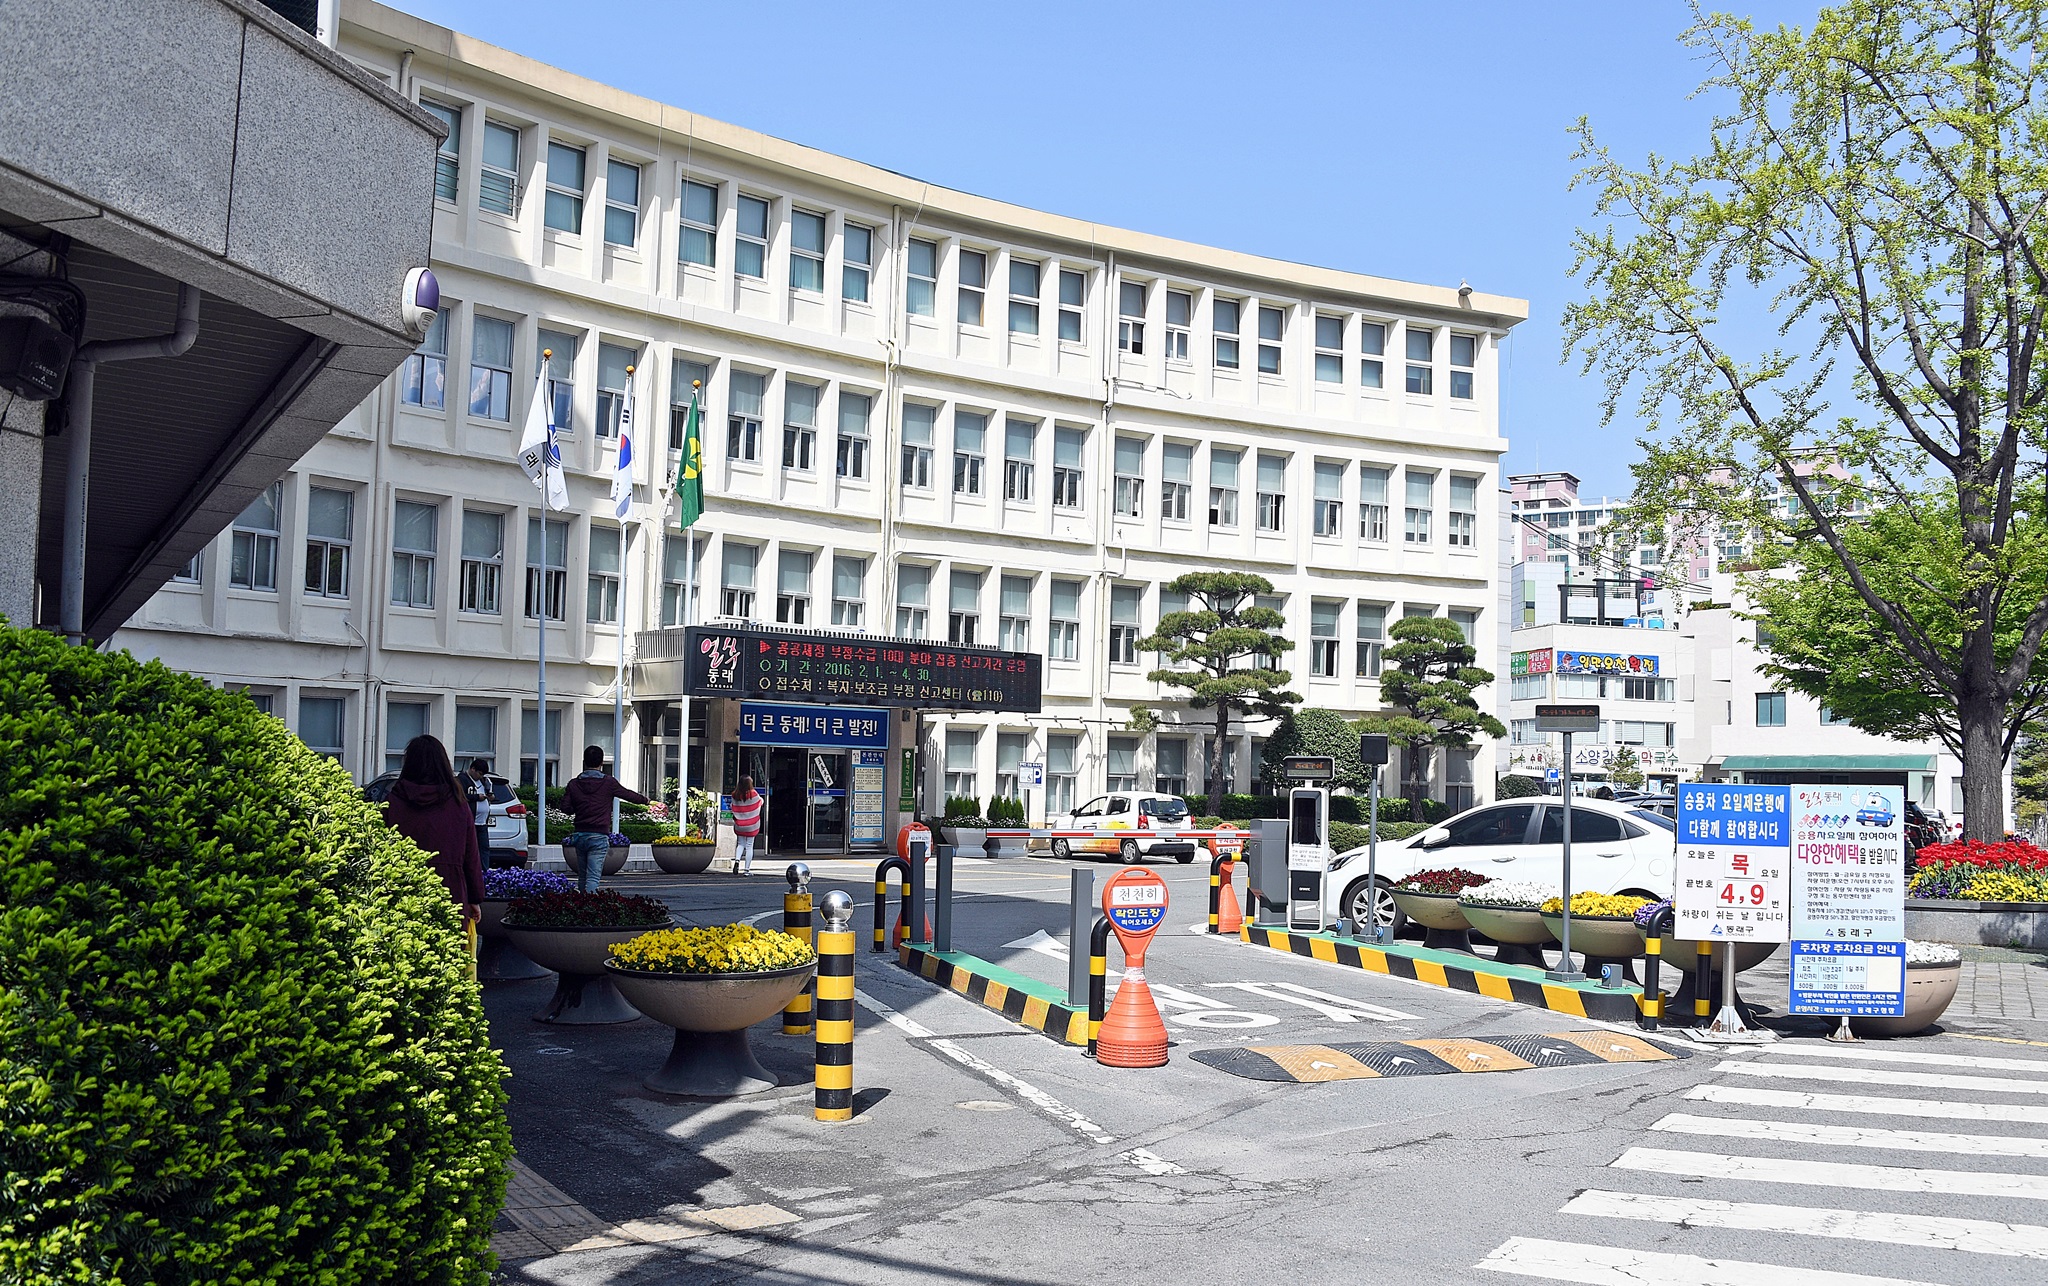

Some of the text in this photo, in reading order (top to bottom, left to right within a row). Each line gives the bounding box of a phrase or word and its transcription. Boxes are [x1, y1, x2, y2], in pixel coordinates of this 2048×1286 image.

[778, 641, 825, 658] 공공재정
[832, 645, 877, 662] 부정수급
[910, 652, 932, 666] 분야
[936, 654, 956, 668] 집중
[962, 656, 1002, 671] 신고기간
[1006, 659, 1026, 673] 운영
[1578, 654, 1627, 670] 일만오천
[707, 668, 734, 684] 동래
[776, 676, 812, 692] 접수처
[892, 684, 914, 698] 부정
[920, 686, 962, 702] 신고센터
[744, 714, 878, 736] 더 큰 동래! 더 큰 발전!
[1684, 792, 1784, 813] 승용차 요일제운행에
[1824, 792, 1842, 802] 동래
[1689, 819, 1720, 838] 다함께
[1726, 820, 1778, 840] 참여합시다
[1859, 832, 1898, 841] 참여하여
[1688, 850, 1778, 878] 오늘은 목 요일
[1119, 888, 1157, 902] 천천히
[1686, 879, 1713, 888] 끝번호
[1772, 900, 1779, 908] 번
[1115, 908, 1160, 918] 확인도장
[1682, 910, 1784, 921] 차량이 쉬는 날 입니다
[1726, 926, 1754, 934] 동래구
[1838, 928, 1872, 937] 동래구
[1800, 943, 1896, 954] 주차장 주차요금 안내
